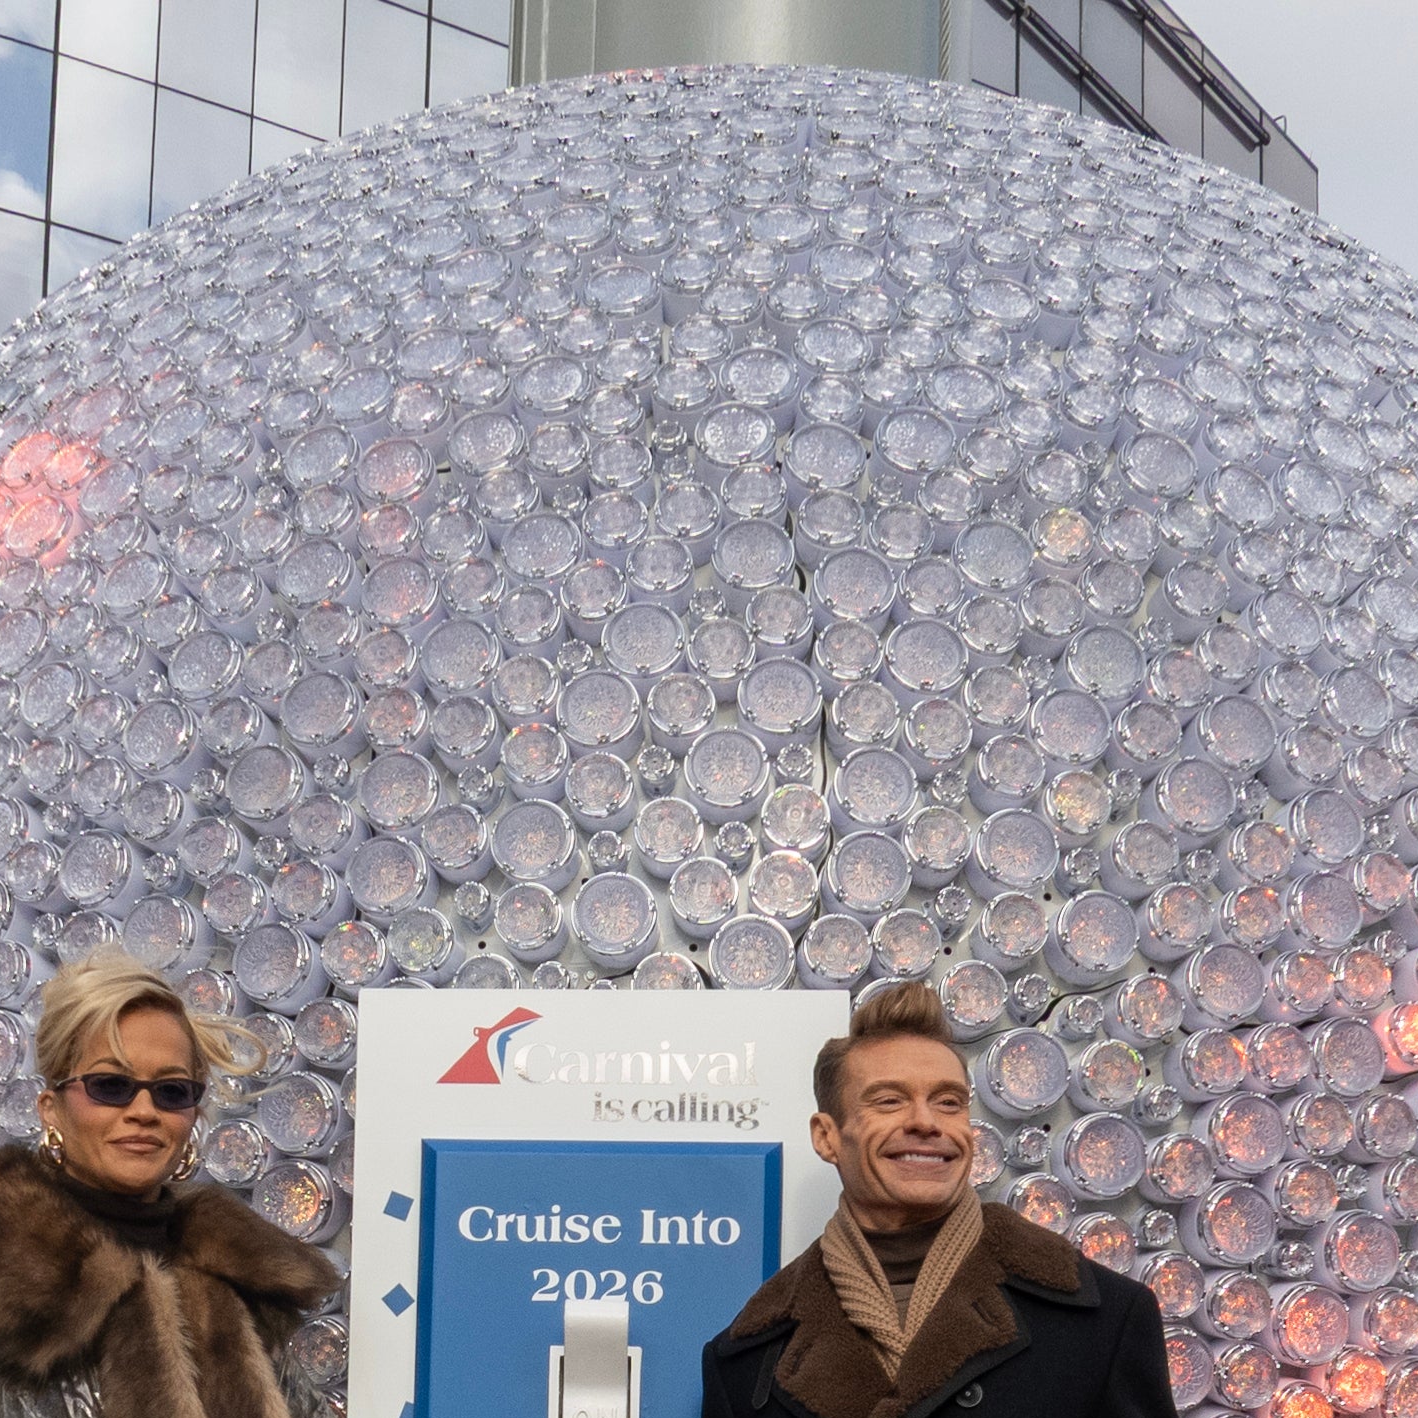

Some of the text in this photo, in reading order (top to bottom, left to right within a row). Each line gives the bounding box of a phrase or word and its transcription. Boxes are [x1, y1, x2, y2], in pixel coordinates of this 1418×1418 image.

[514, 1040, 758, 1085] Carnival
[592, 1091, 624, 1122] is
[458, 1205, 741, 1246] Cruise Into
[531, 1269, 663, 1304] 2026
